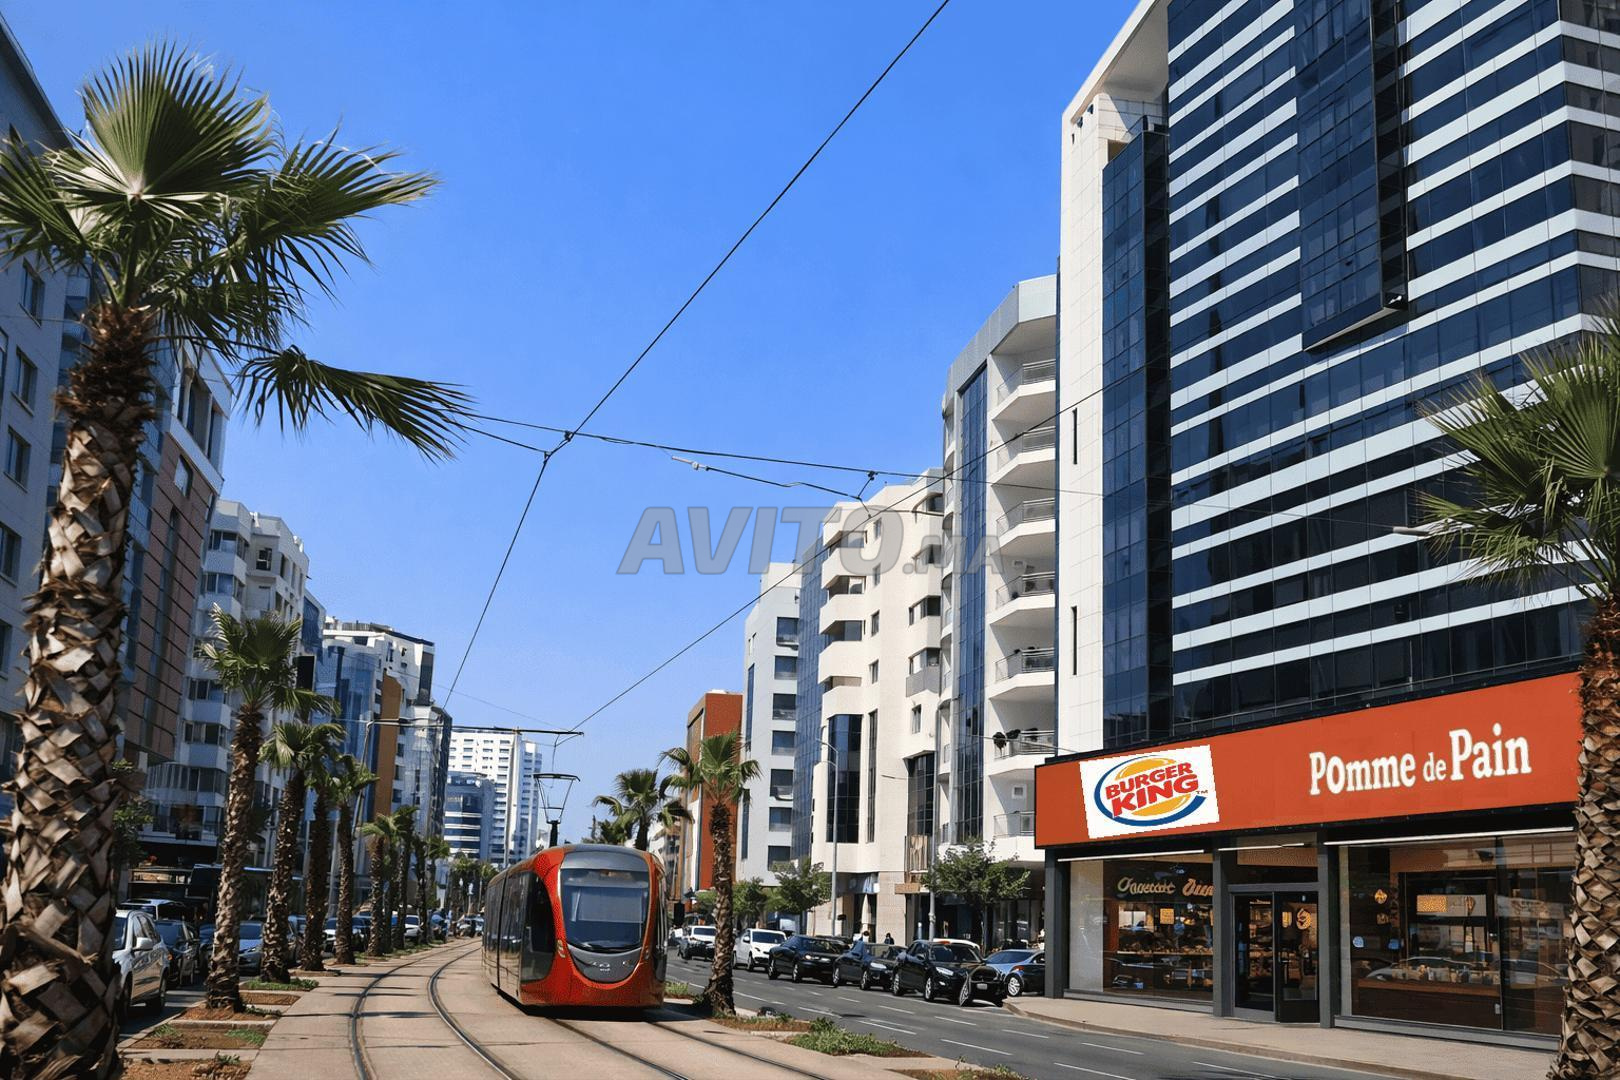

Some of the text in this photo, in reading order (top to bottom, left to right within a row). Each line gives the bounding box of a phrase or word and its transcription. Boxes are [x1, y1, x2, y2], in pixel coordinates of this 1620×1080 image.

[1309, 722, 1532, 795] Pomme de Pain
[1105, 762, 1194, 800] BURGER
[1111, 773, 1199, 817] KING
